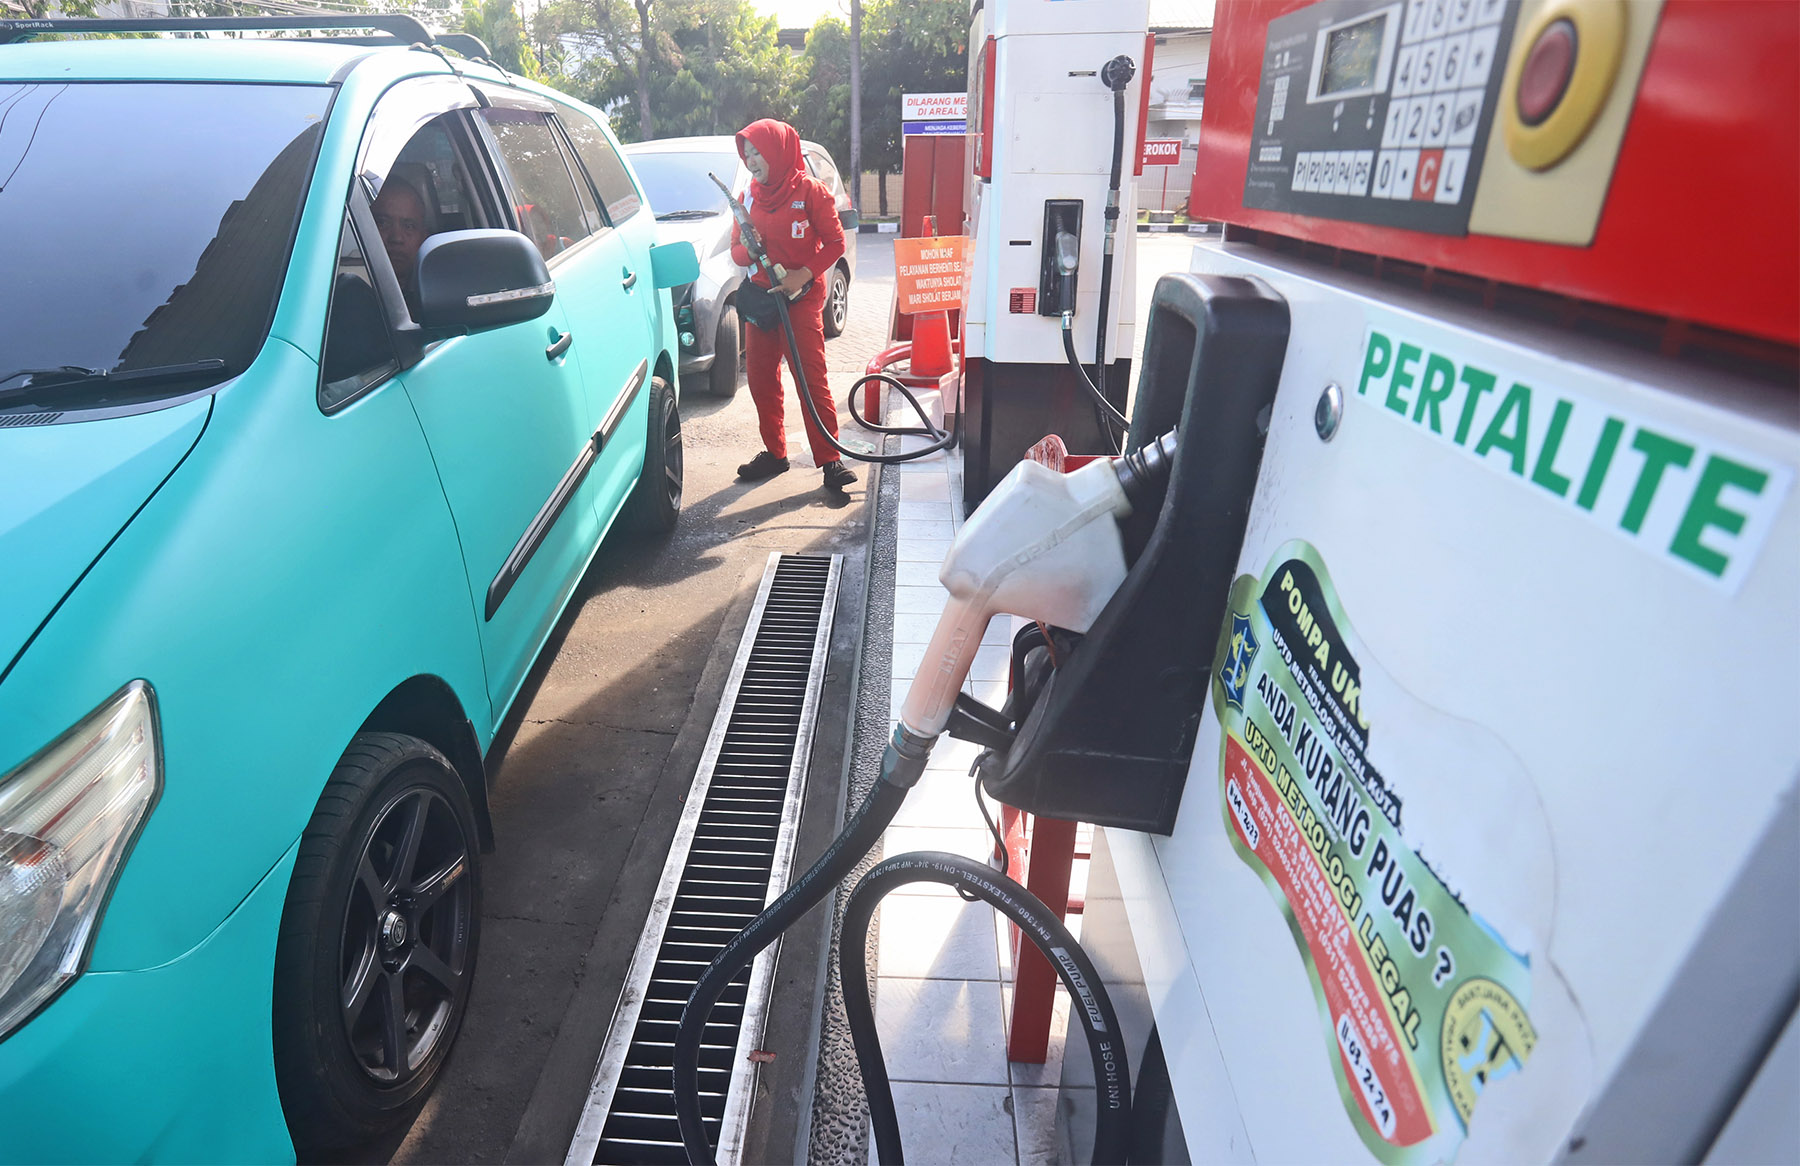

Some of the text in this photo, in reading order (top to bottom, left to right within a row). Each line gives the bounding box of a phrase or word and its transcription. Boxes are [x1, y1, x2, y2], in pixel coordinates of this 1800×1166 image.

[14, 21, 54, 30] SportRack
[1400, 44, 1459, 88] 4 5 6
[906, 96, 968, 106] DILARANG ME
[917, 108, 928, 116] DI
[928, 107, 959, 115] AREAL
[1391, 103, 1446, 141] 1 2 3
[1295, 161, 1307, 183] P1
[1308, 161, 1321, 184] P2
[1322, 161, 1336, 184] P3
[1337, 161, 1351, 183] P4
[1353, 161, 1369, 185] P5
[1379, 159, 1391, 190] 0
[1419, 156, 1436, 194] C
[1444, 157, 1455, 193] L
[899, 264, 929, 276] PELAYANAN
[929, 262, 953, 274] BERHENTI
[920, 247, 954, 260] MOHON MAAF
[908, 293, 922, 305] MARI
[921, 291, 941, 303] SHOLAT
[915, 277, 943, 289] WAKTUNYA
[1358, 331, 1770, 579] PERTALITE
[1280, 569, 1330, 671] POMPA
[1272, 628, 1399, 824] UPTD METROLOGI LEGAL KOTA
[1257, 672, 1296, 743] ANDA
[1294, 721, 1370, 856] KURANG
[1367, 838, 1431, 953] PUAS
[800, 848, 836, 888] COMBUSTIBLE
[1244, 717, 1277, 775] UPTD
[1276, 762, 1363, 921] METROLOGI
[1358, 912, 1421, 1051] LEGAL
[1276, 801, 1299, 848] KOTA
[1299, 845, 1350, 947] SURABAYA
[962, 870, 1012, 905] FLEXSTEEL
[1018, 907, 1038, 928] 1360
[1037, 925, 1052, 941] EN
[1059, 955, 1102, 1023] FUEL PUMP
[1100, 1041, 1117, 1081] HOSE
